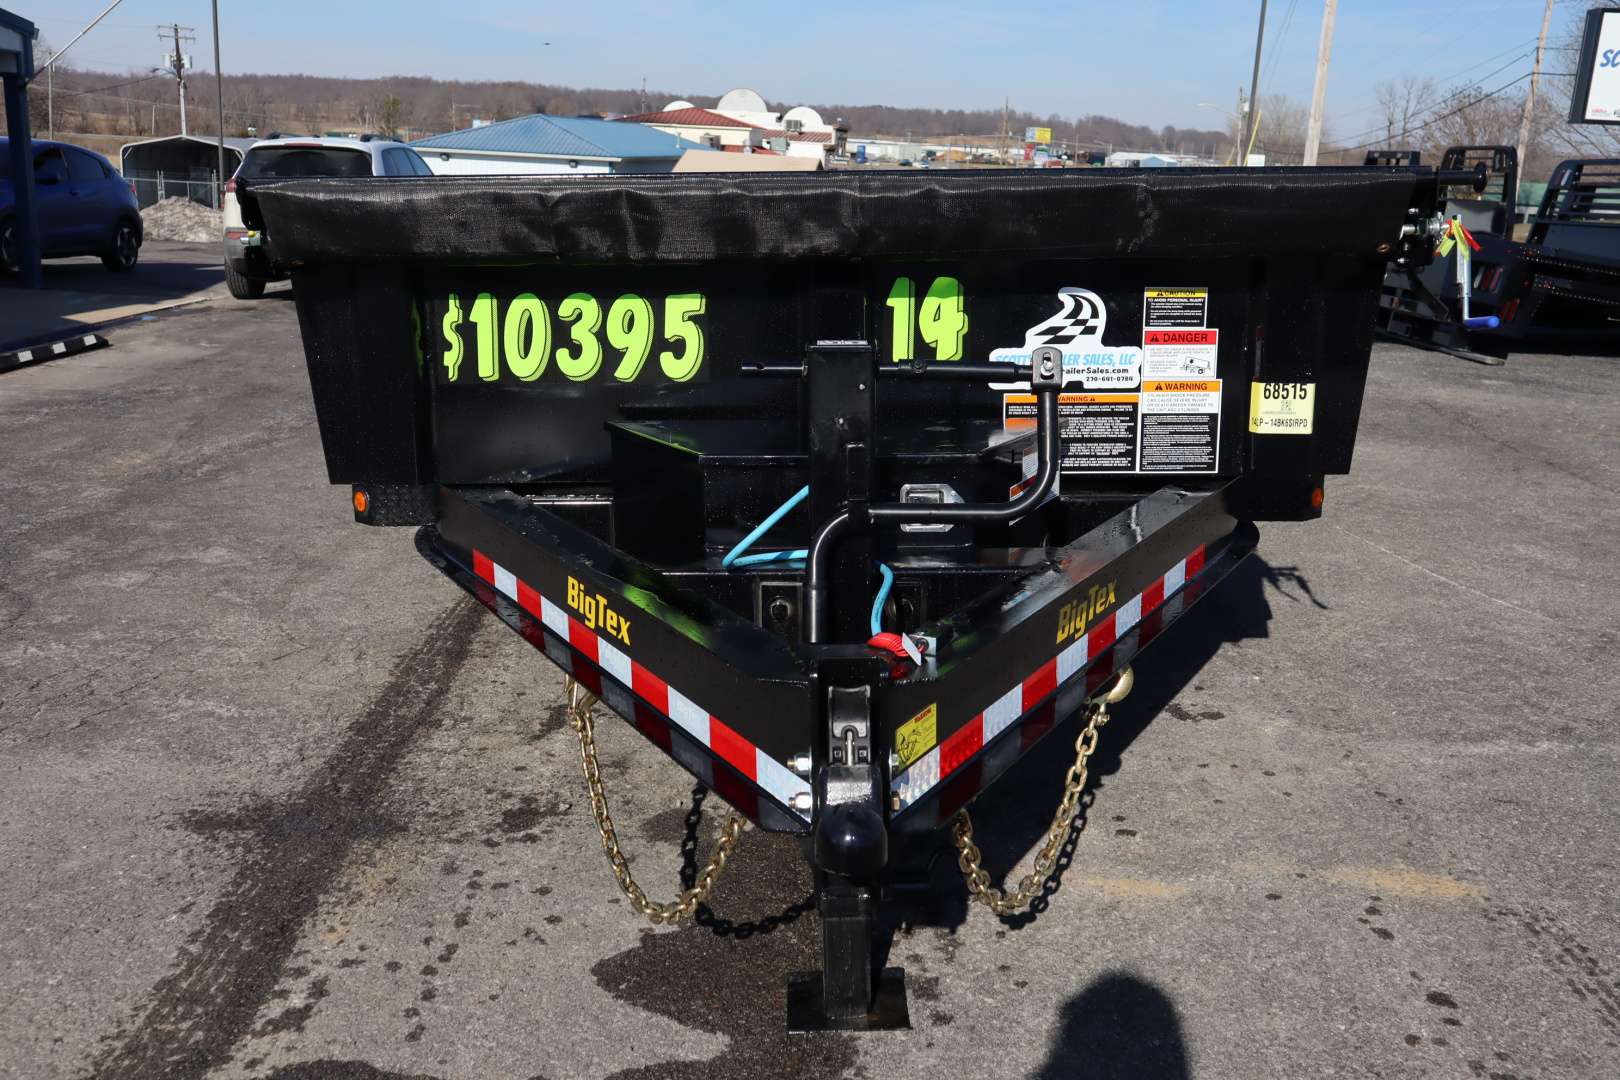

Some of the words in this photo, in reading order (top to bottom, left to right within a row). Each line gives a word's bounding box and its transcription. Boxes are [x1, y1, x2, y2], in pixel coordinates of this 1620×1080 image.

[1600, 49, 1620, 68] SC
[442, 292, 706, 382] $10395
[886, 276, 968, 362] 14
[1163, 333, 1208, 342] DANGER
[996, 354, 1032, 366] SCOTT'
[1083, 354, 1116, 367] SALES,
[1119, 354, 1136, 365] LLC
[1264, 383, 1307, 400] 68515
[567, 576, 630, 646] BigTex
[1056, 579, 1117, 644] BigTex
